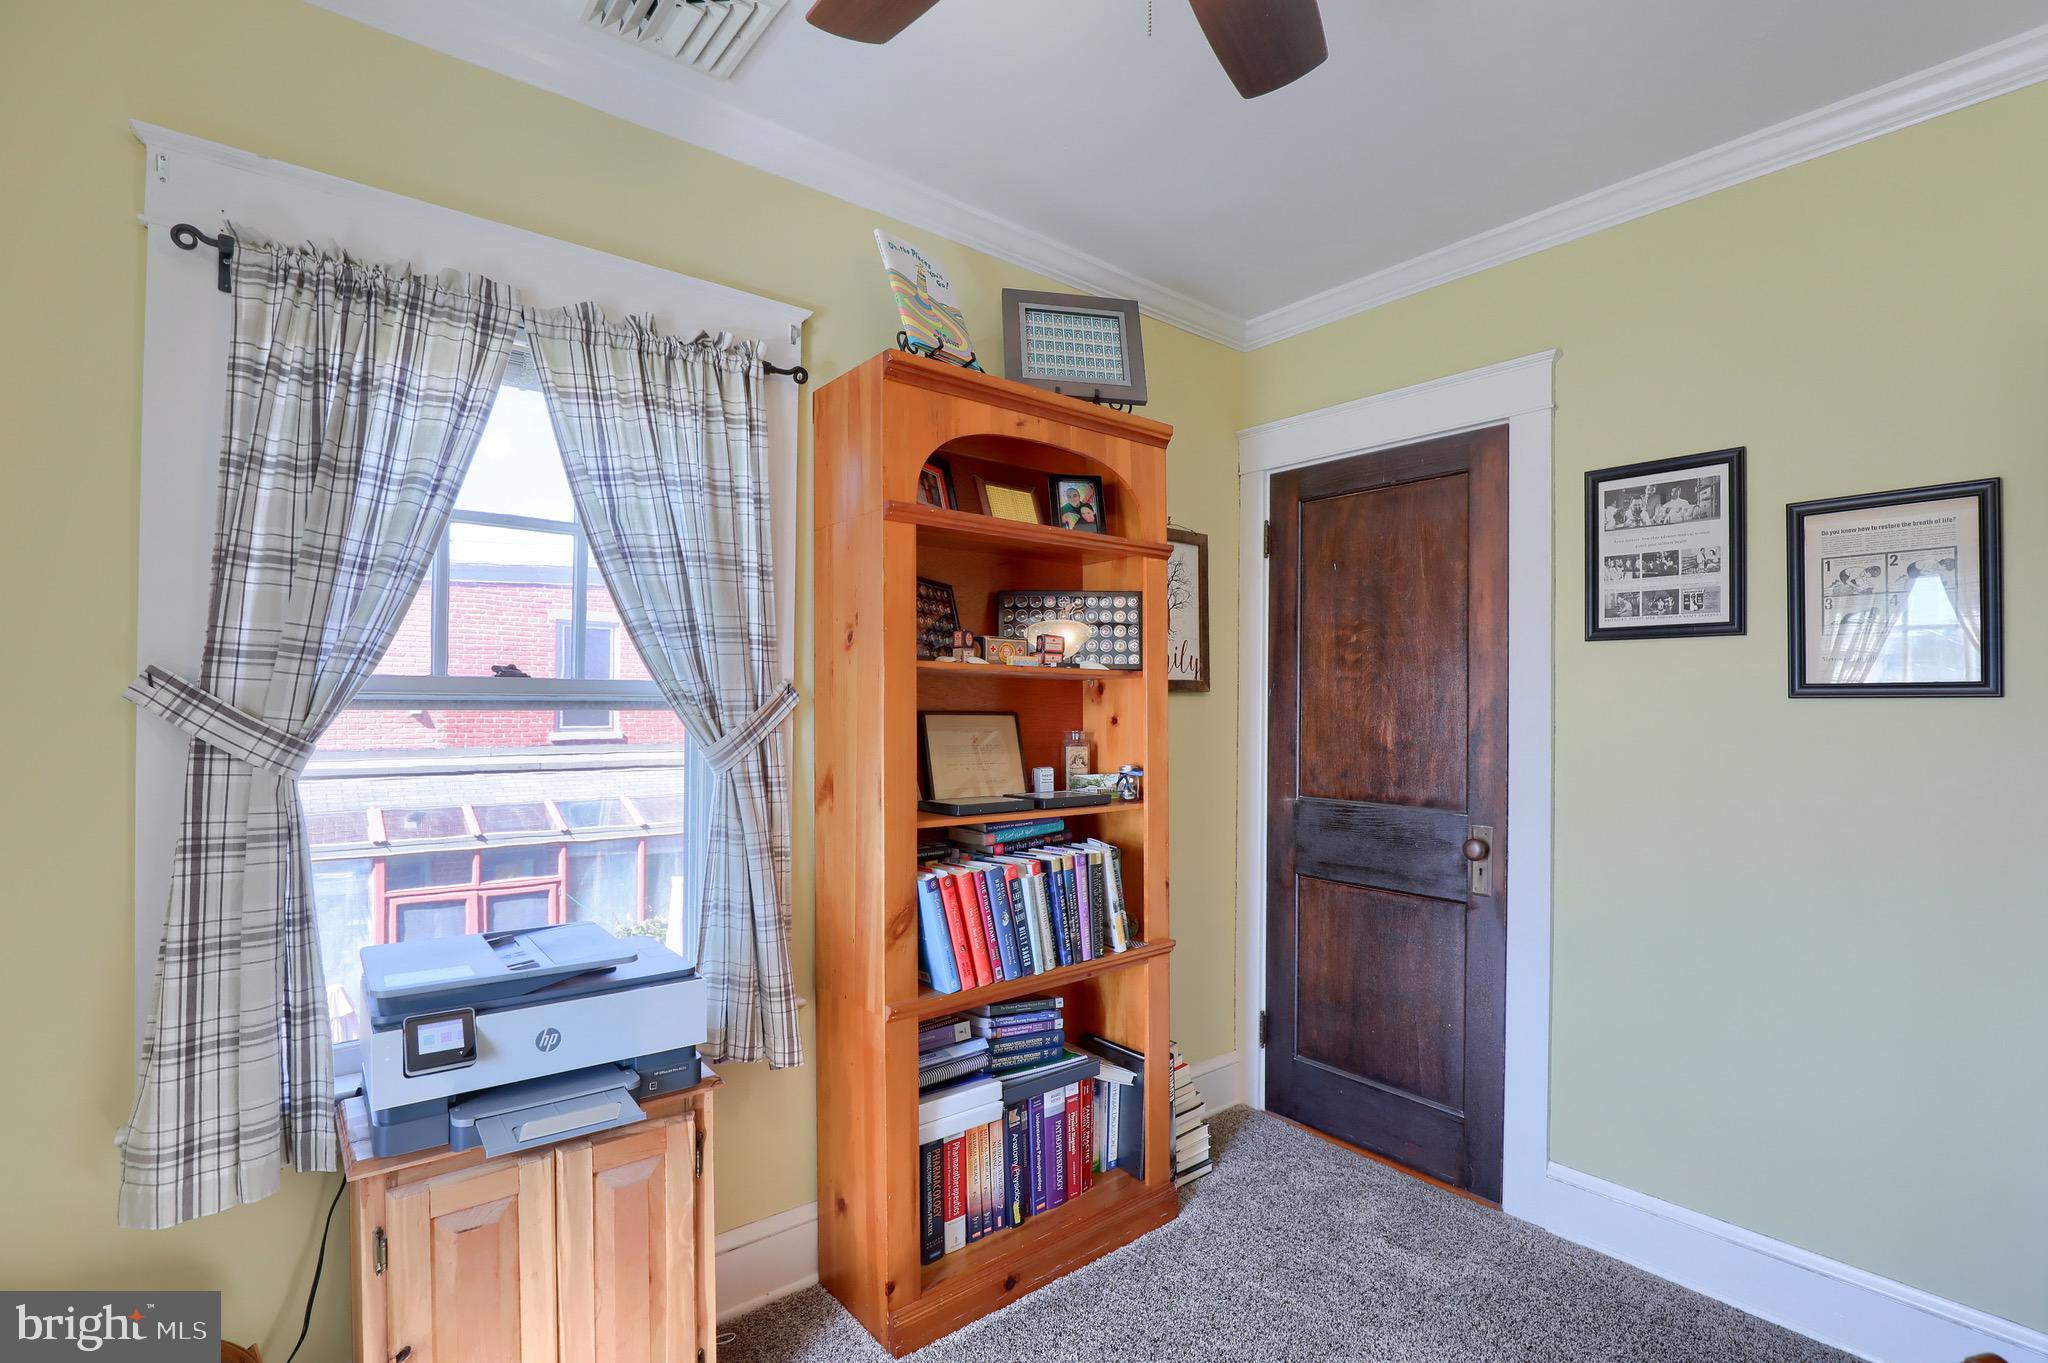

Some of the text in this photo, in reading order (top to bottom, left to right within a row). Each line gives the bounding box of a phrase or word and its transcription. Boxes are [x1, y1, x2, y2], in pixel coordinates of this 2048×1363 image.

[1824, 560, 1831, 572] 1
[1889, 554, 1899, 567] 2
[1824, 598, 1833, 610] 3
[1889, 594, 1899, 607] 4
[987, 915, 995, 944] MISTAKE
[1019, 926, 1027, 945] RILEY
[538, 1027, 560, 1052] hp
[1055, 1120, 1063, 1191] PATHOPHYSIOLOGY
[933, 1148, 941, 1217] PHARMACOLOGY
[952, 1142, 960, 1216] Pharmacotherapeutics
[1011, 1134, 1021, 1206] Anatomy Physiolog
